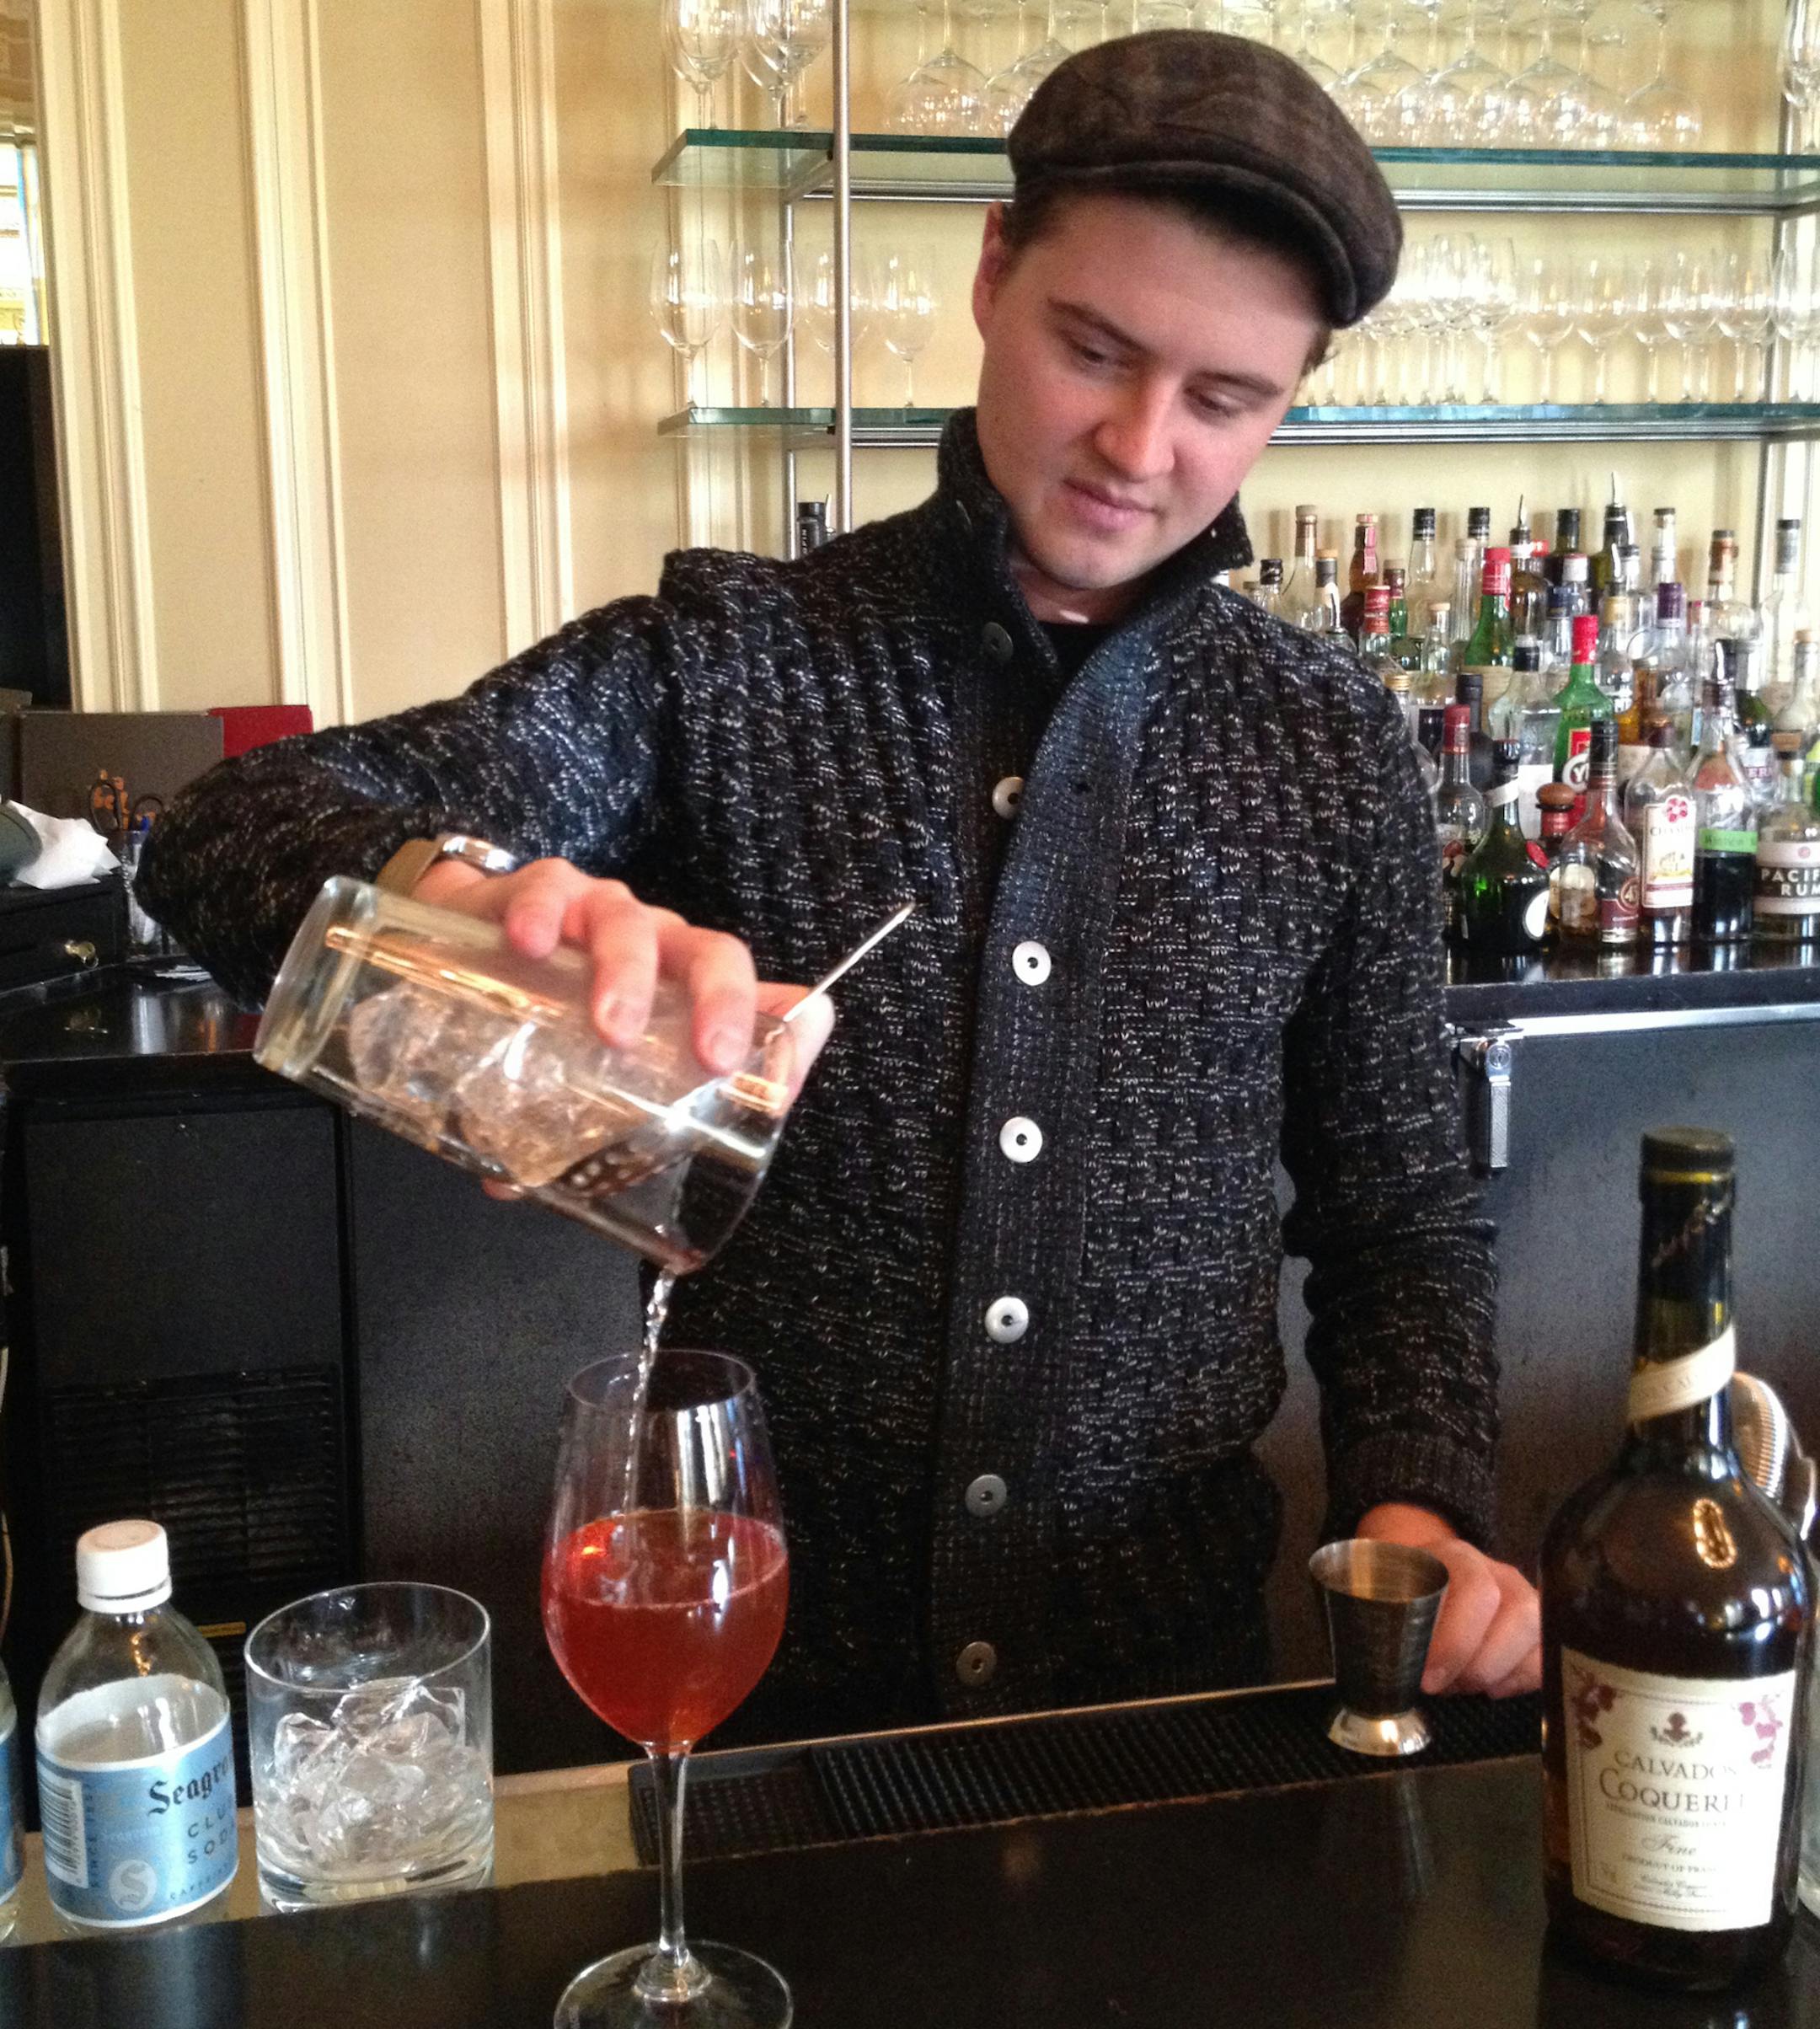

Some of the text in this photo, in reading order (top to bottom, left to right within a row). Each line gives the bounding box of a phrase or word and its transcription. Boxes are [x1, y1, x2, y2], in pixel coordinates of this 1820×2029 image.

[1781, 883, 1820, 897] RUM
[1614, 1749, 1737, 1780] CALVAD
[1599, 1767, 1744, 1813] COQUER
[187, 1802, 228, 1839] CLU
[187, 1827, 232, 1865] SOD
